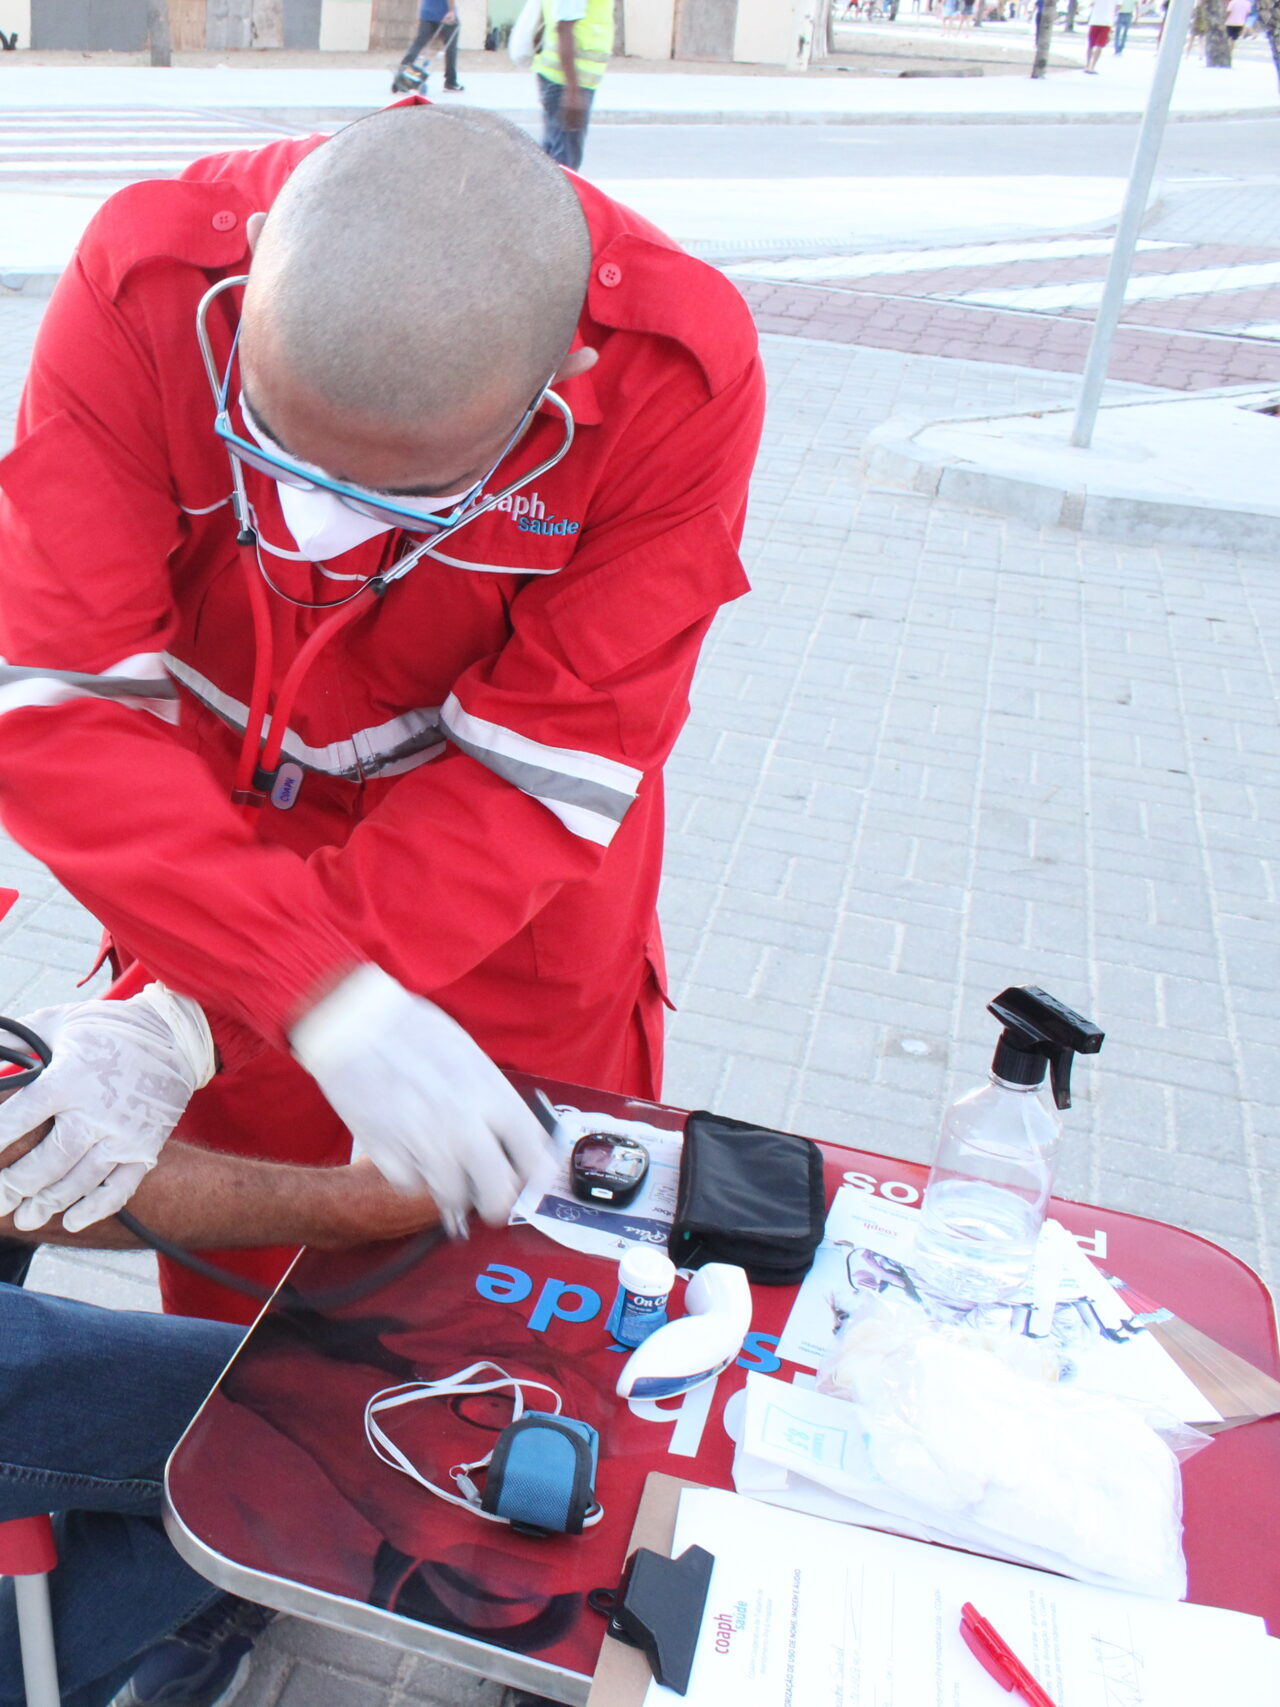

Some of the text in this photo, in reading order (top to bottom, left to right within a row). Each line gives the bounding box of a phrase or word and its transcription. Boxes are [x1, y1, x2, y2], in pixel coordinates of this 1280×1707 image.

[518, 515, 580, 536] saúde
[633, 1295, 654, 1308] On
[791, 1594, 800, 1619] IMAGEM
[733, 1600, 748, 1631] saúde
[713, 1613, 738, 1655] coaph
[788, 1639, 797, 1649] DE
[787, 1649, 796, 1663] USO
[786, 1663, 795, 1673] DE
